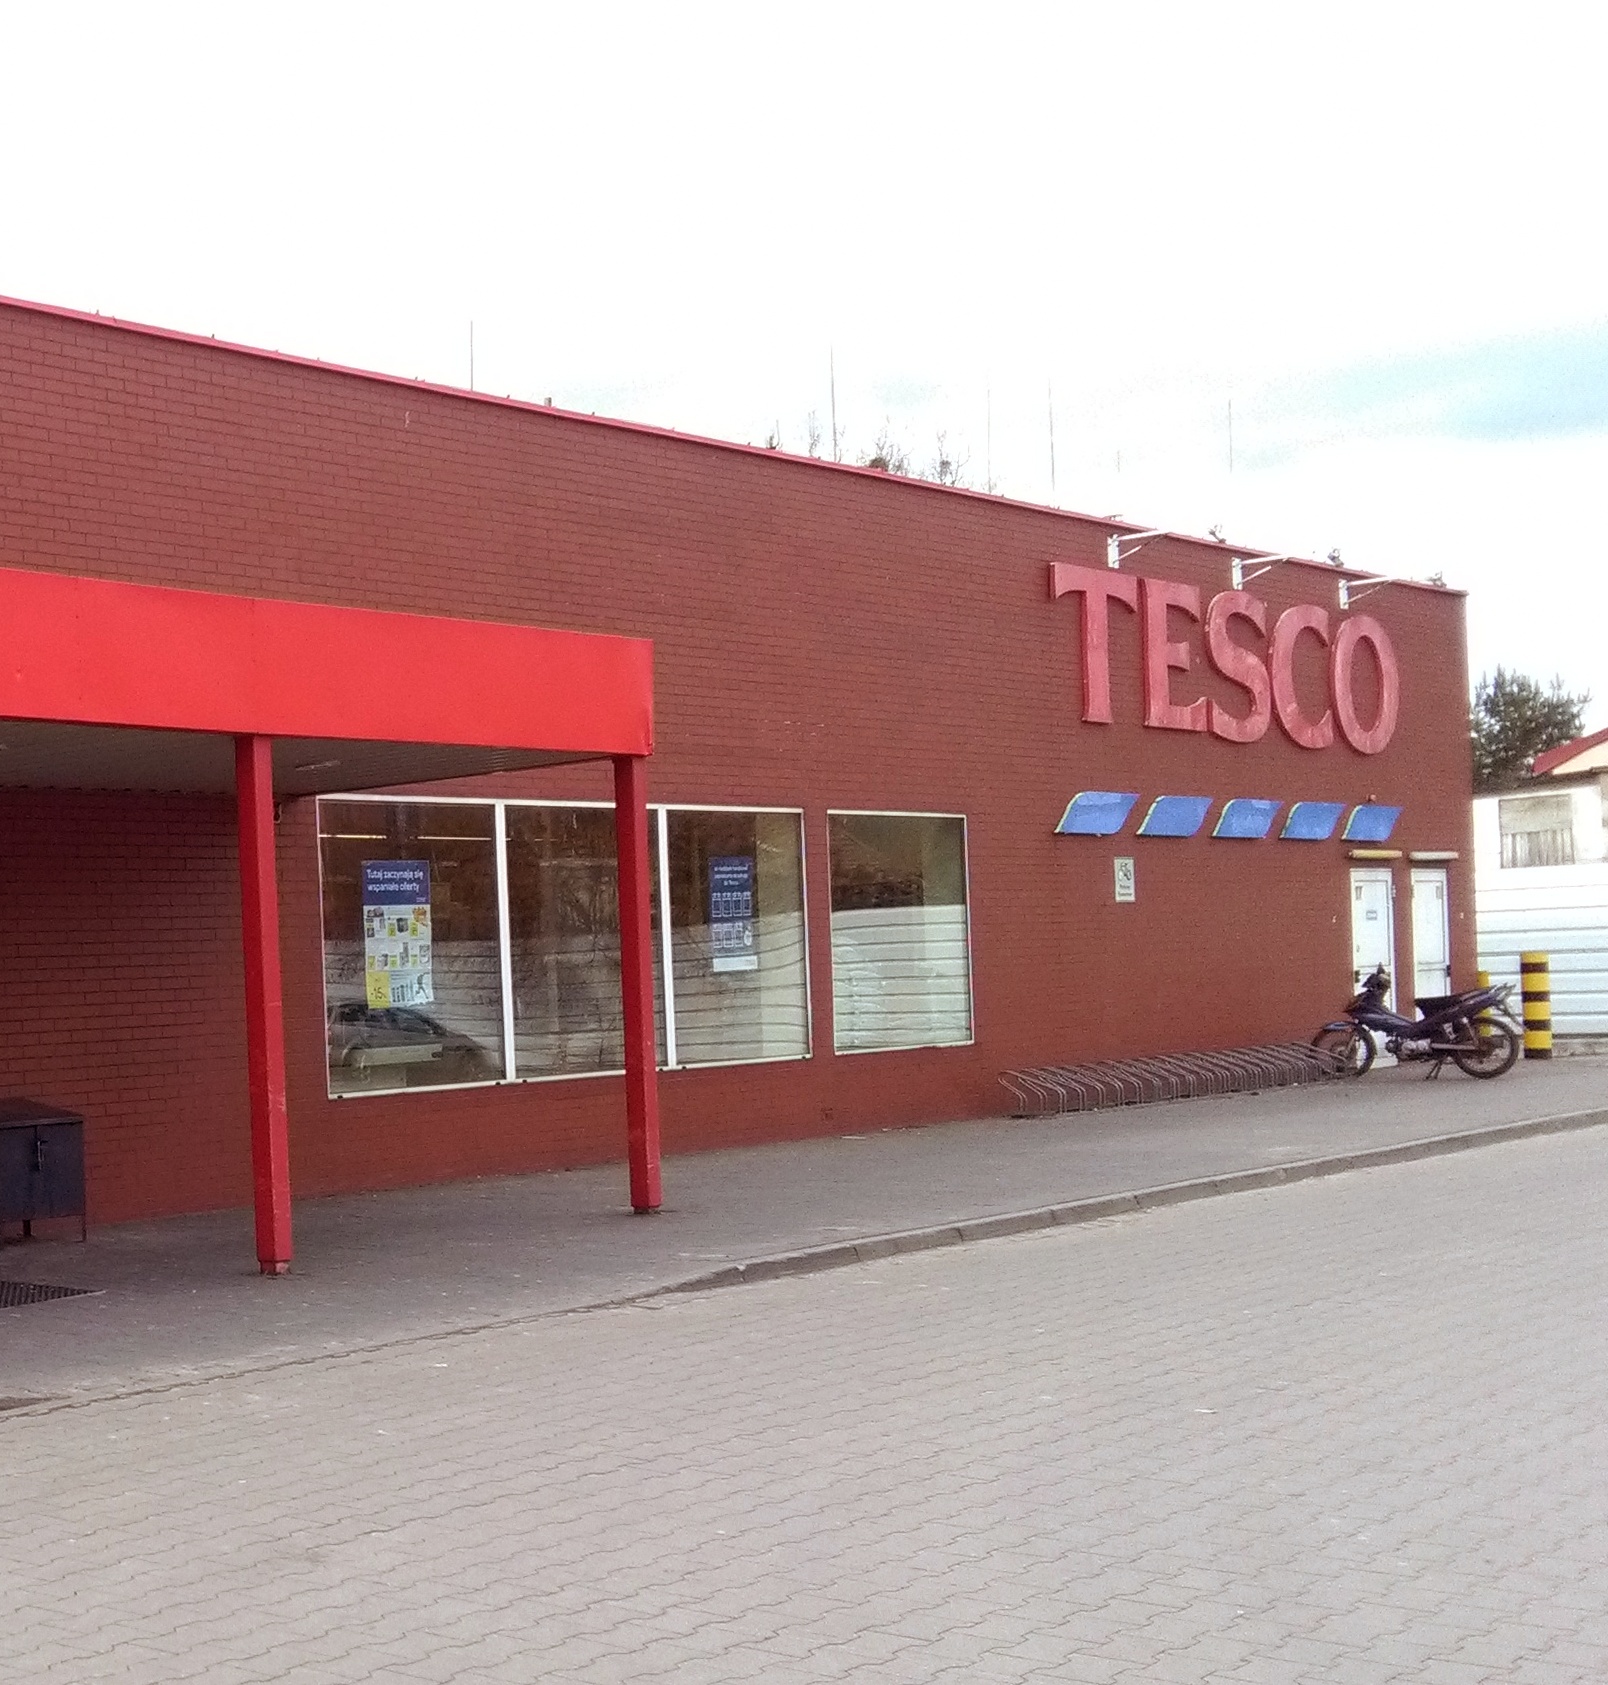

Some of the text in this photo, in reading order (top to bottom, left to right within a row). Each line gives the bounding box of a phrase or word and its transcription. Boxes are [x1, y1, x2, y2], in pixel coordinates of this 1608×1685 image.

[1048, 561, 1399, 755] TESCO
[366, 869, 383, 880] Tutaj
[400, 882, 420, 893] oferty
